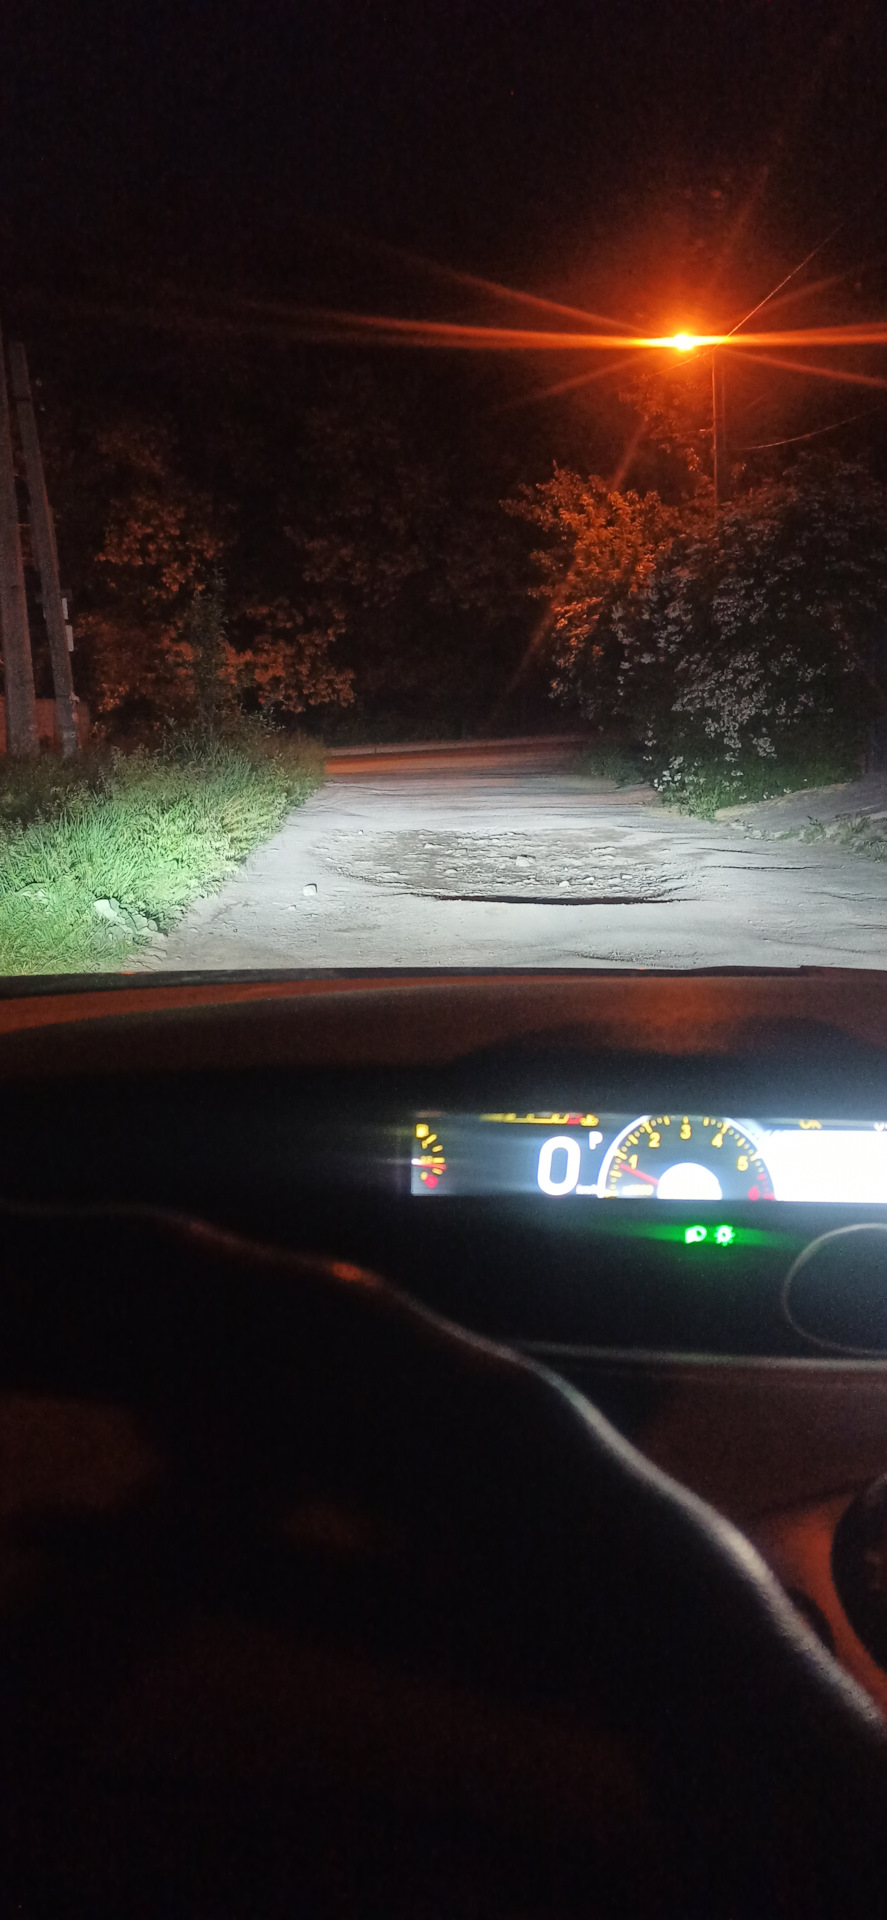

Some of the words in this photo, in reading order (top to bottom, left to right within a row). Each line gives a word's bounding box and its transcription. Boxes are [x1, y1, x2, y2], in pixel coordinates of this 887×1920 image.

[589, 1131, 603, 1150] P
[648, 1131, 661, 1148] 2
[680, 1124, 692, 1140] 3
[711, 1132, 724, 1149] 4
[537, 1136, 581, 1196] 0
[628, 1154, 639, 1170] 1
[736, 1155, 749, 1172] 5
[748, 1185, 760, 1201] 6
